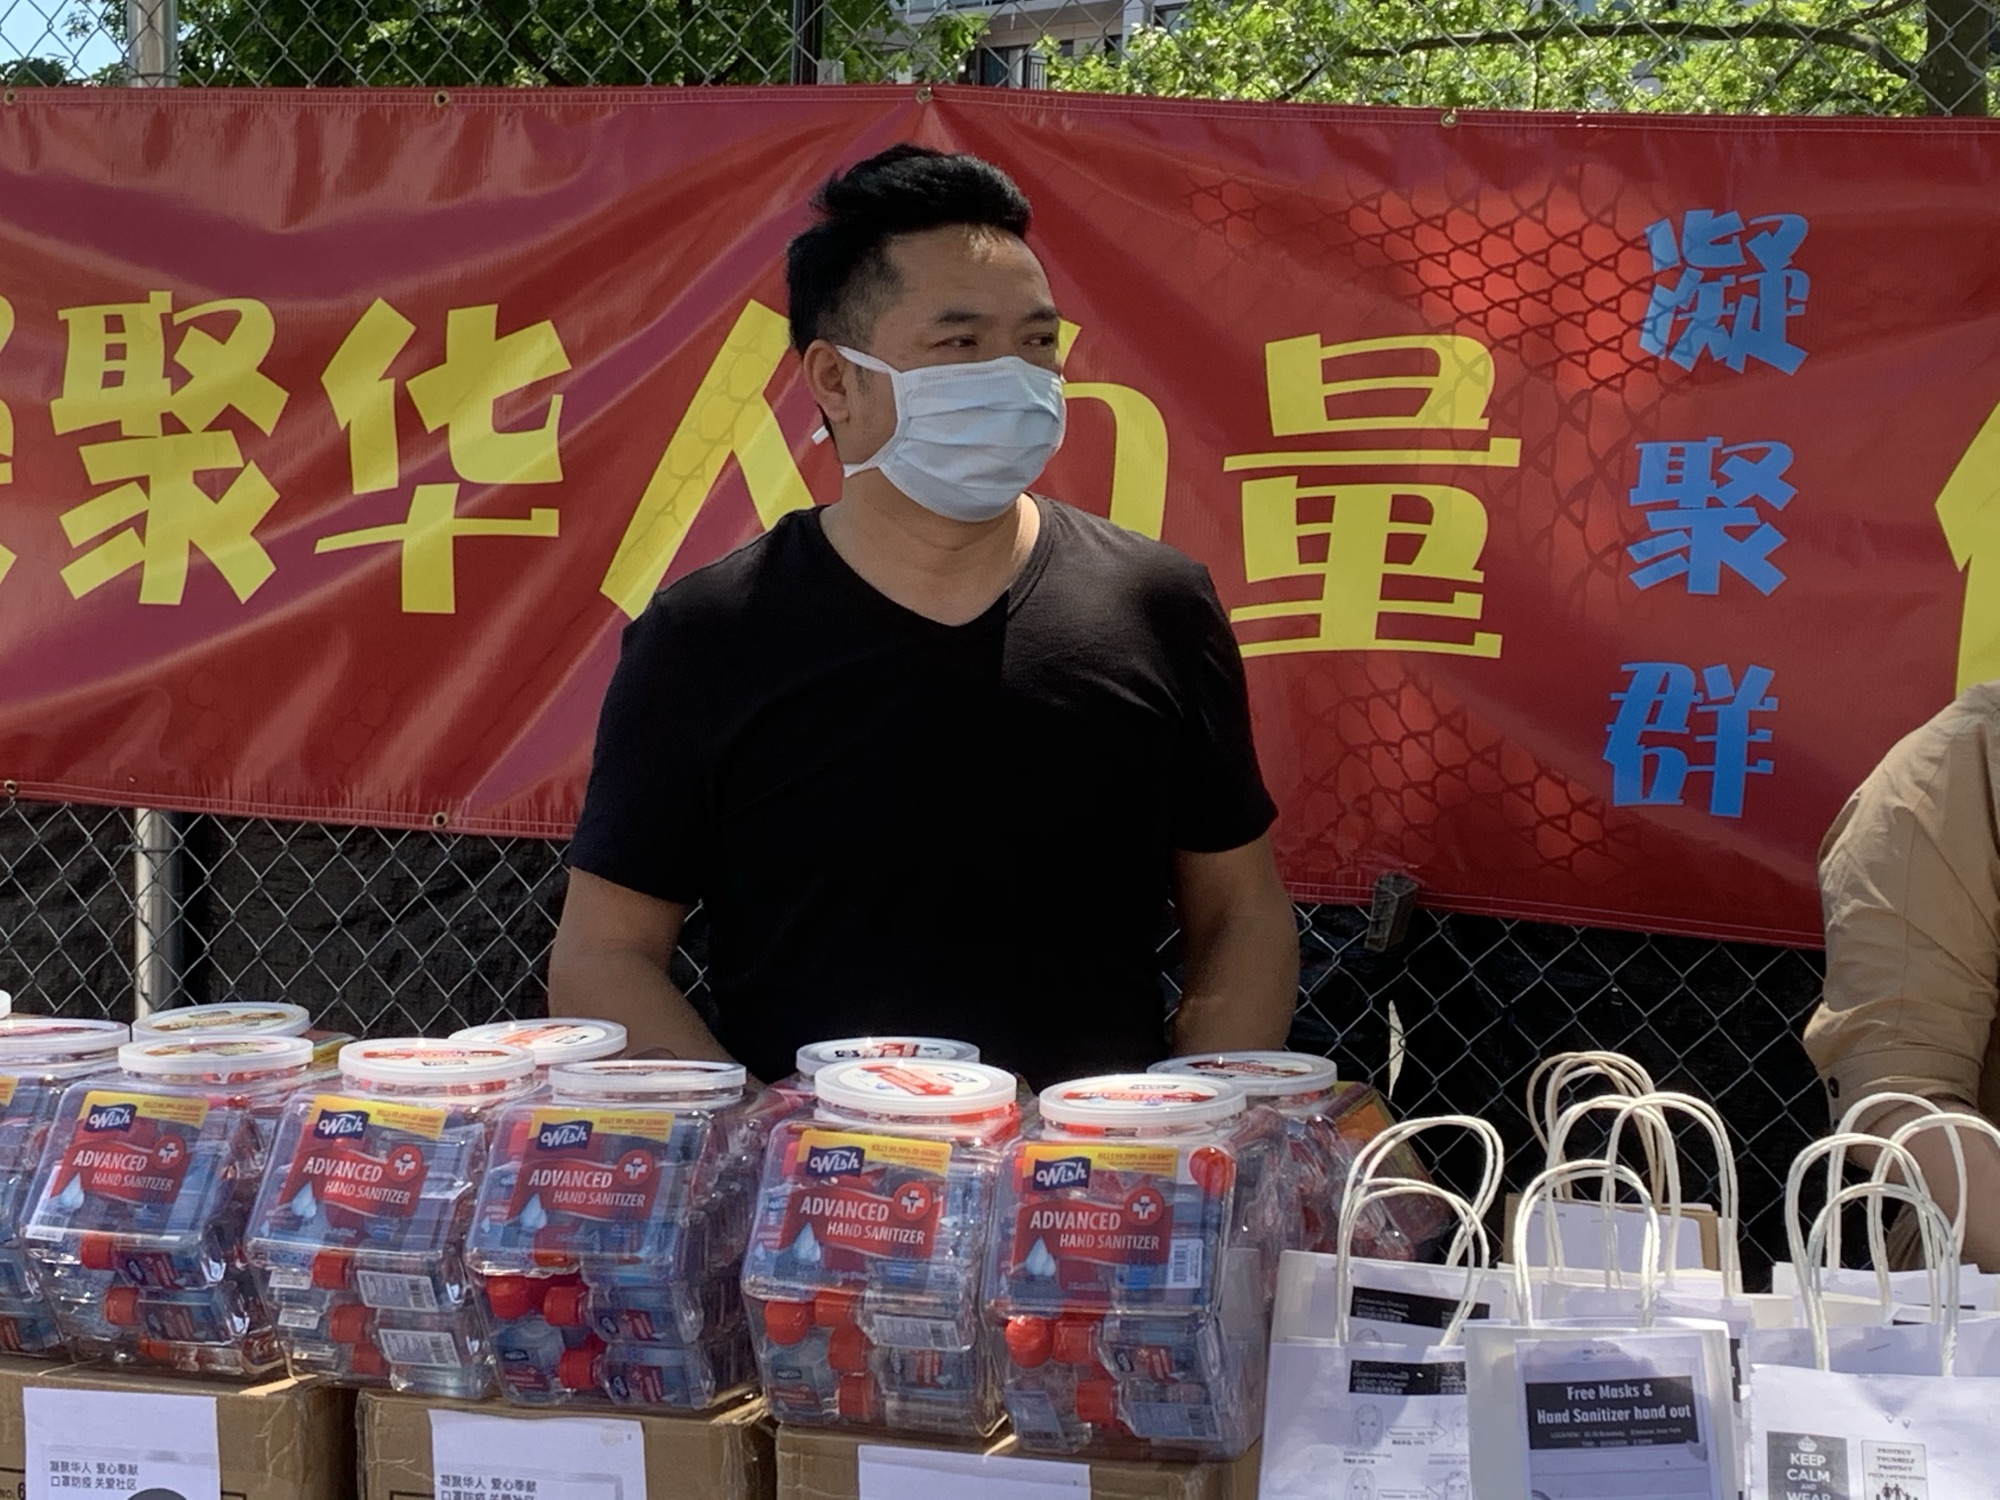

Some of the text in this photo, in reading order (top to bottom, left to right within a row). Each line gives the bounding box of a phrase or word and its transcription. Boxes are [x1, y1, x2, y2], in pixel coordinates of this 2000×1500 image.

[1603, 208, 1810, 818] 凝聚群
[89, 1108, 131, 1128] Wish
[318, 1113, 363, 1135] Wish
[541, 1125, 588, 1147] Wish
[73, 1150, 148, 1172] ADVANCED
[303, 1157, 383, 1182] ADVANCED
[809, 1150, 860, 1173] Wish
[92, 1172, 174, 1191] HAND SANITIZER
[528, 1169, 612, 1189] ADVANCED
[1036, 1162, 1087, 1186] Wish
[324, 1181, 411, 1205] HAND SANITIZER
[553, 1191, 646, 1207] HAND SANITIZER
[800, 1196, 889, 1222] ADVANCED
[1029, 1210, 1121, 1231] ADVANCED
[826, 1221, 925, 1245] HAND SANITIZER
[1060, 1233, 1160, 1250] HAND SANITIZER
[1567, 1383, 1653, 1400] Free Masks &
[1536, 1404, 1692, 1425] Hand Sanitizer hand out
[1790, 1453, 1827, 1466] KEEP
[1786, 1469, 1830, 1483] CALM
